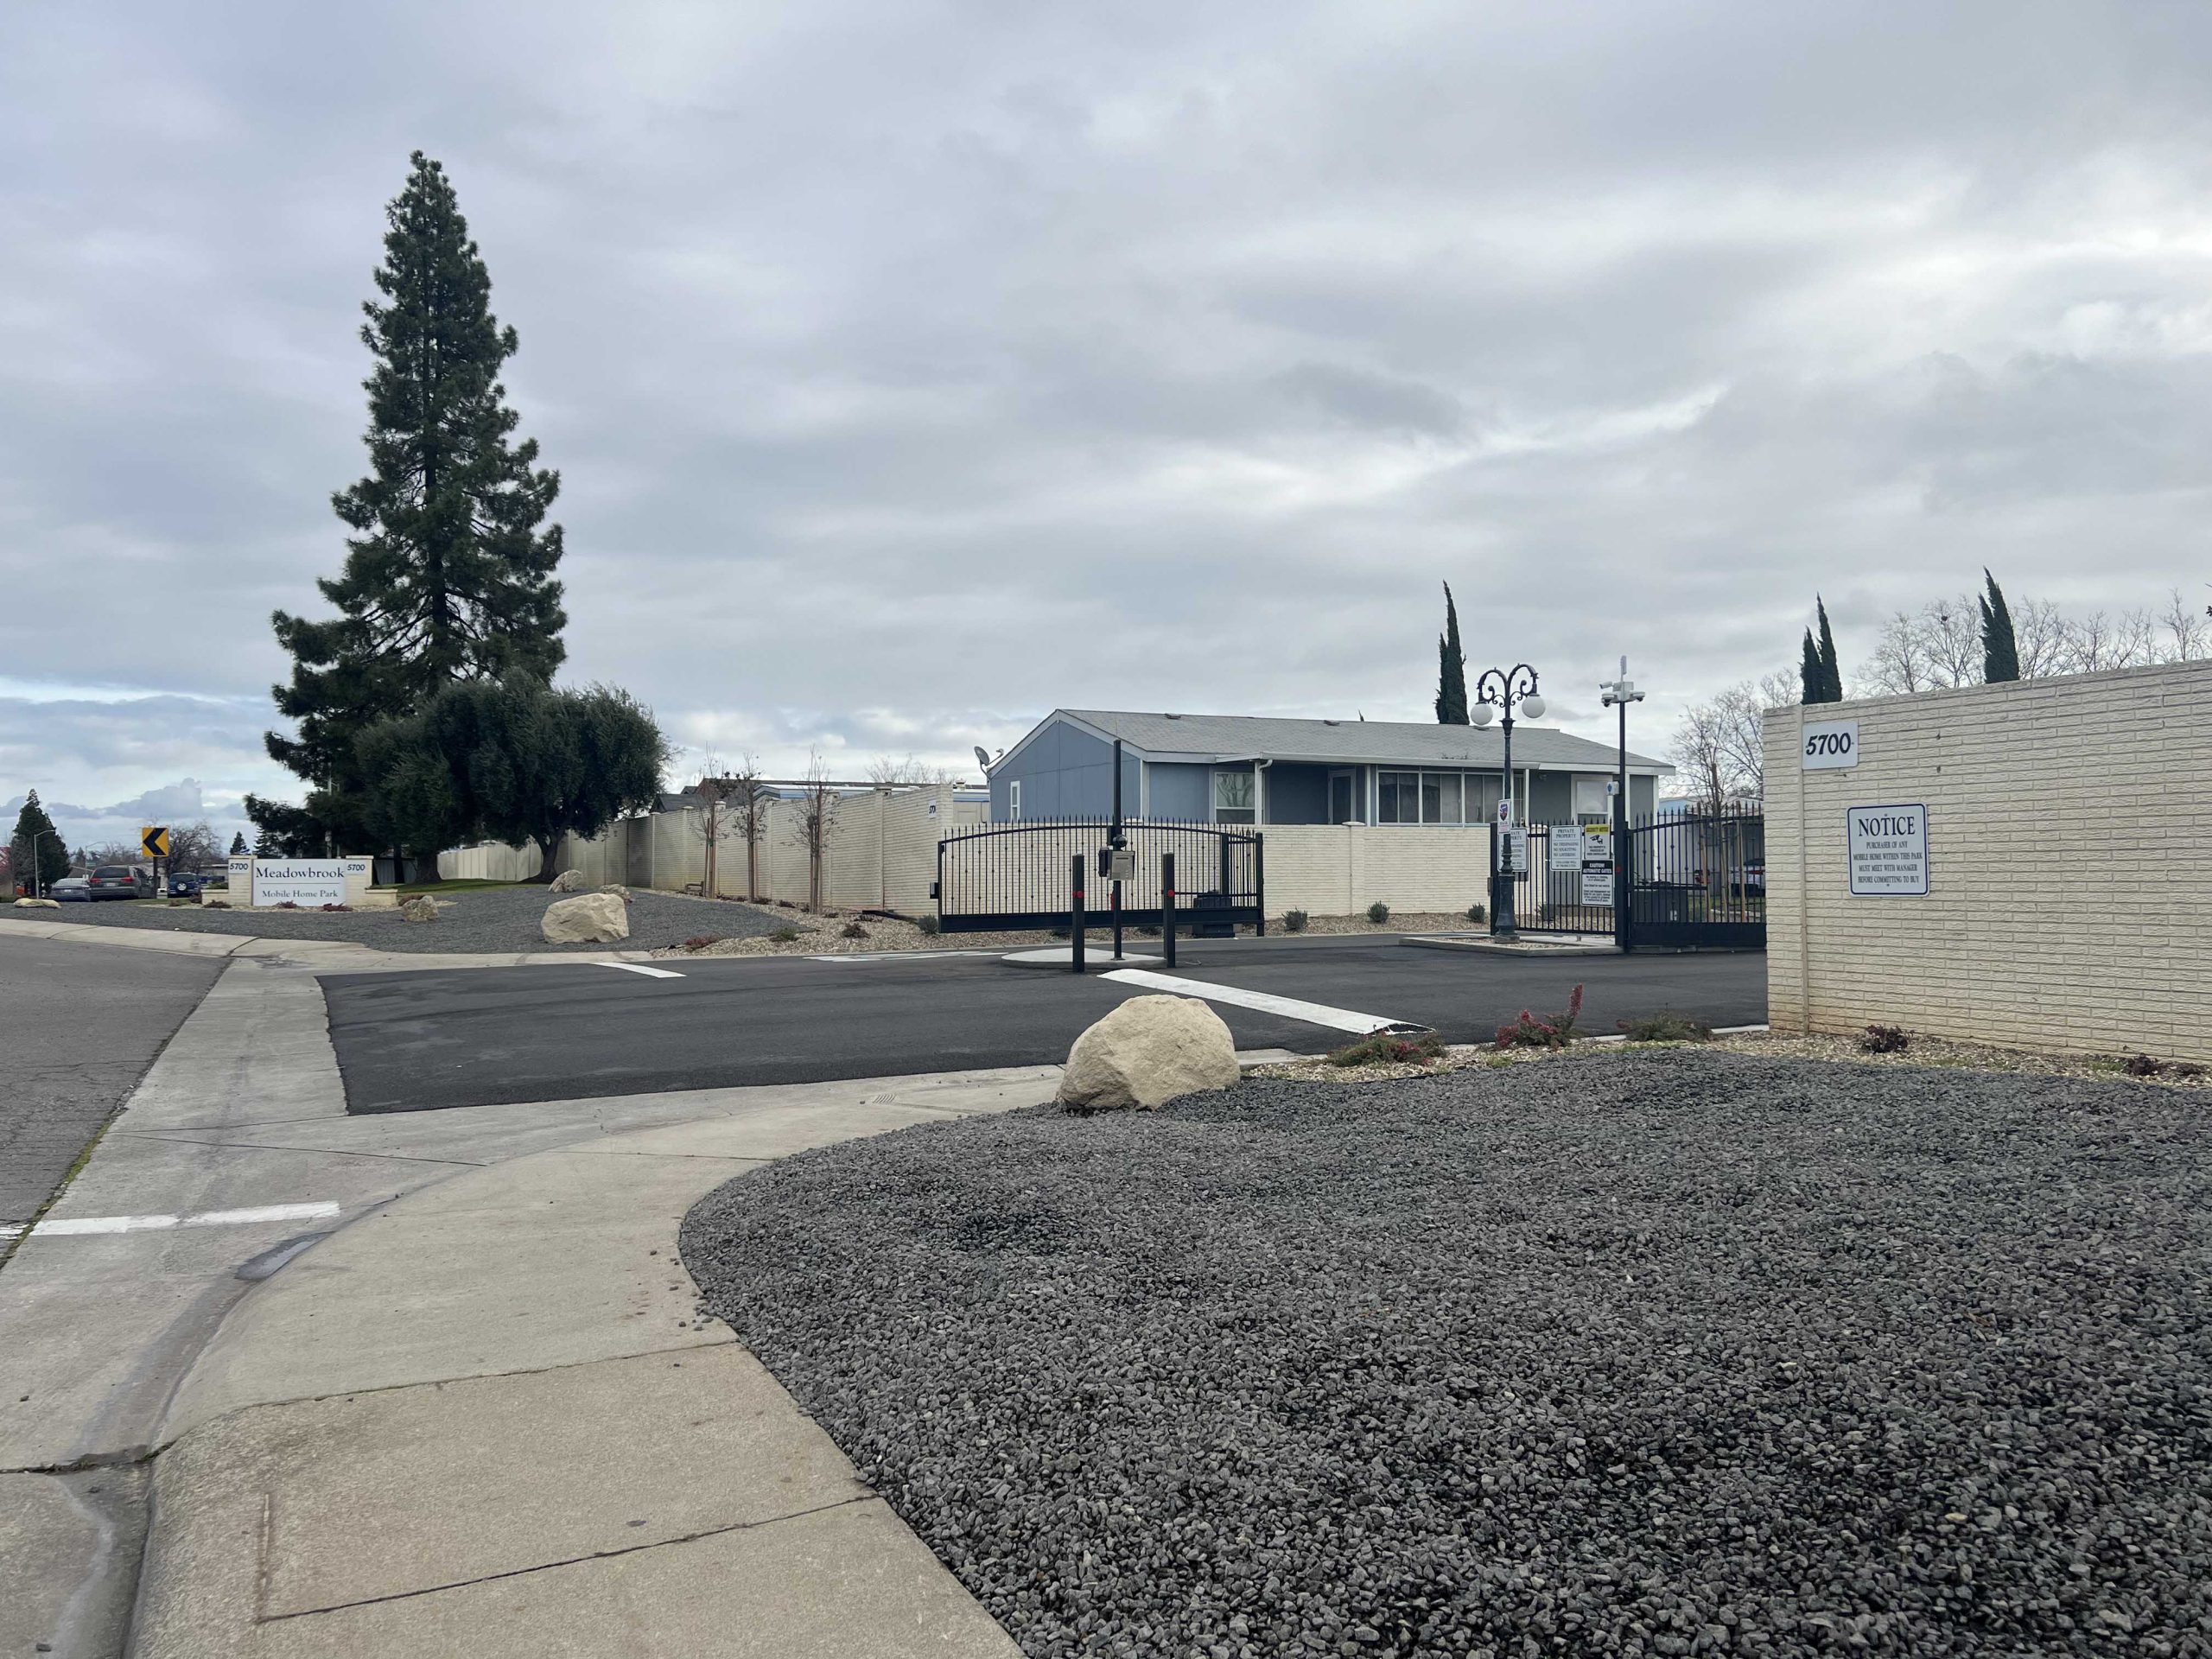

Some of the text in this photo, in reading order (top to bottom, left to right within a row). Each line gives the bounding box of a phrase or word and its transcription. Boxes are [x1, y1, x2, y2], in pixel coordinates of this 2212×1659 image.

[1806, 732, 1852, 755] 5700
[1858, 816, 1916, 837] NOTICE
[1866, 841, 1891, 849] PURCHASER
[255, 867, 345, 878] Meadowbrook
[262, 889, 338, 898] Mobile Home Park
